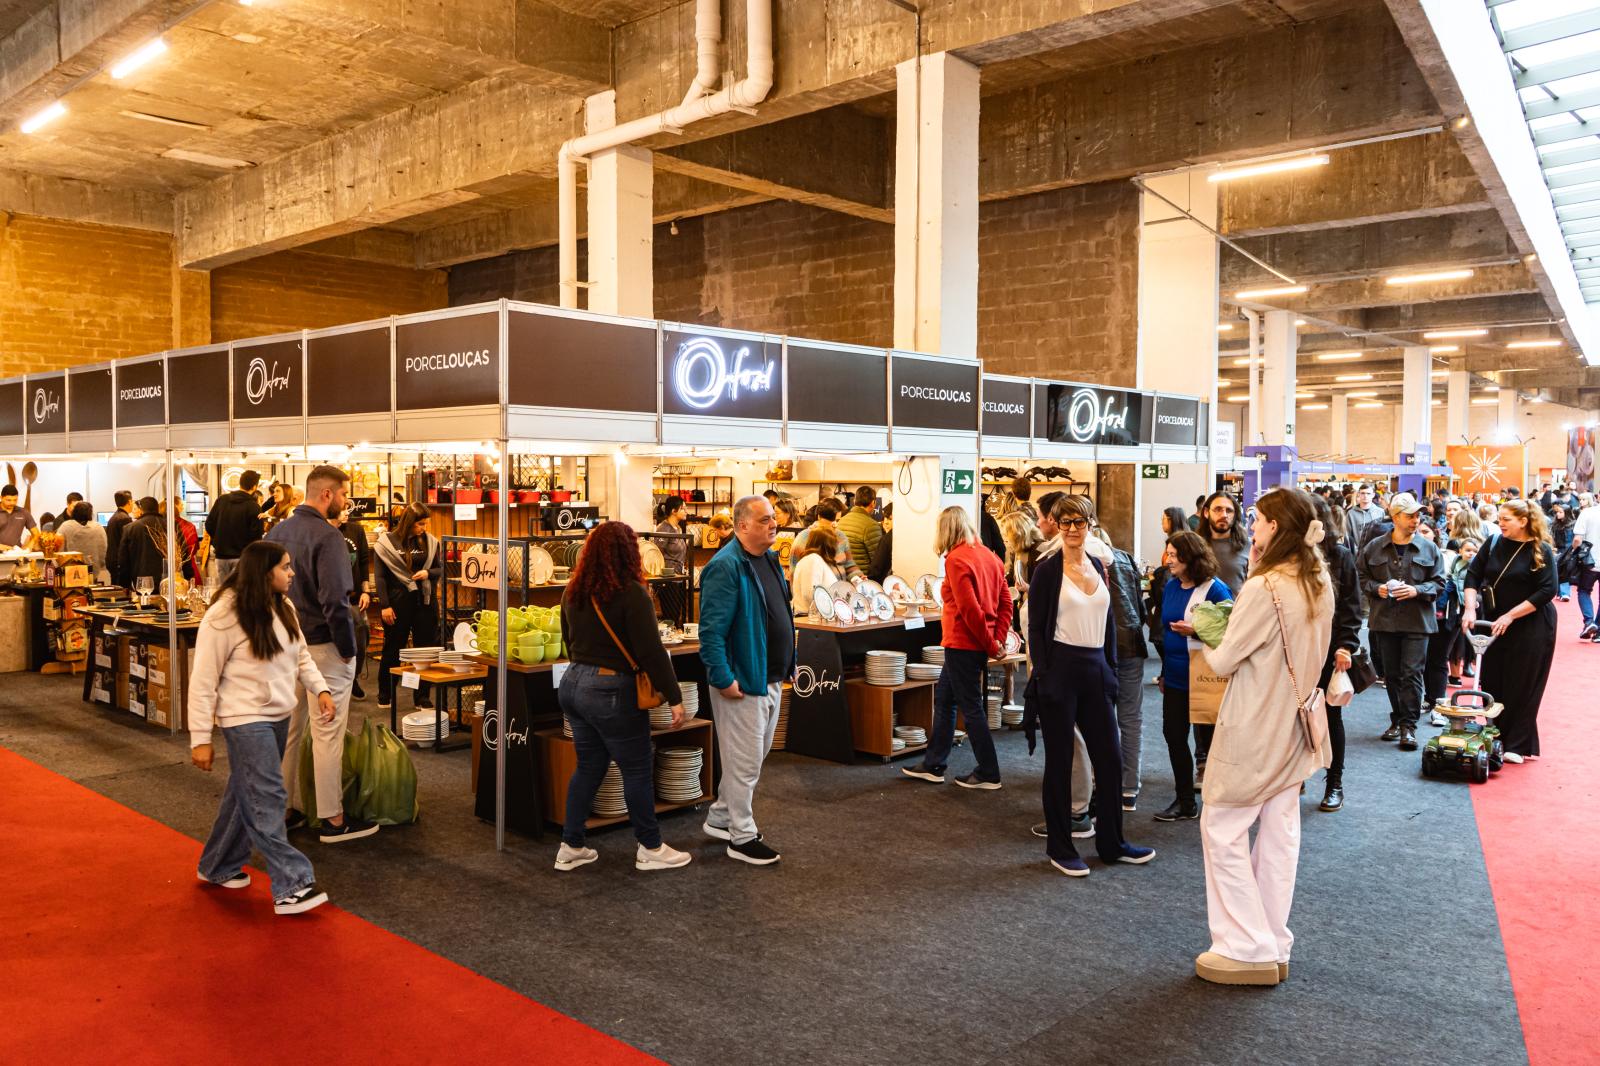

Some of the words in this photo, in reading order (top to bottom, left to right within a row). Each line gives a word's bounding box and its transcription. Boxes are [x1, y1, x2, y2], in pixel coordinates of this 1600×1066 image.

[405, 349, 490, 373] PORCELOUÇAS
[673, 337, 774, 409] Oxford
[120, 385, 162, 401] PORCELOUÇAS
[246, 357, 291, 405] Oxford
[901, 385, 971, 403] PORCELOUÇAS
[34, 388, 60, 424] Oxford
[981, 401, 1025, 415] RCELOUÇAS
[1069, 388, 1129, 442] Oxford
[557, 509, 589, 530] Oxford
[465, 557, 497, 584] Oxford
[793, 665, 840, 698] Oxford
